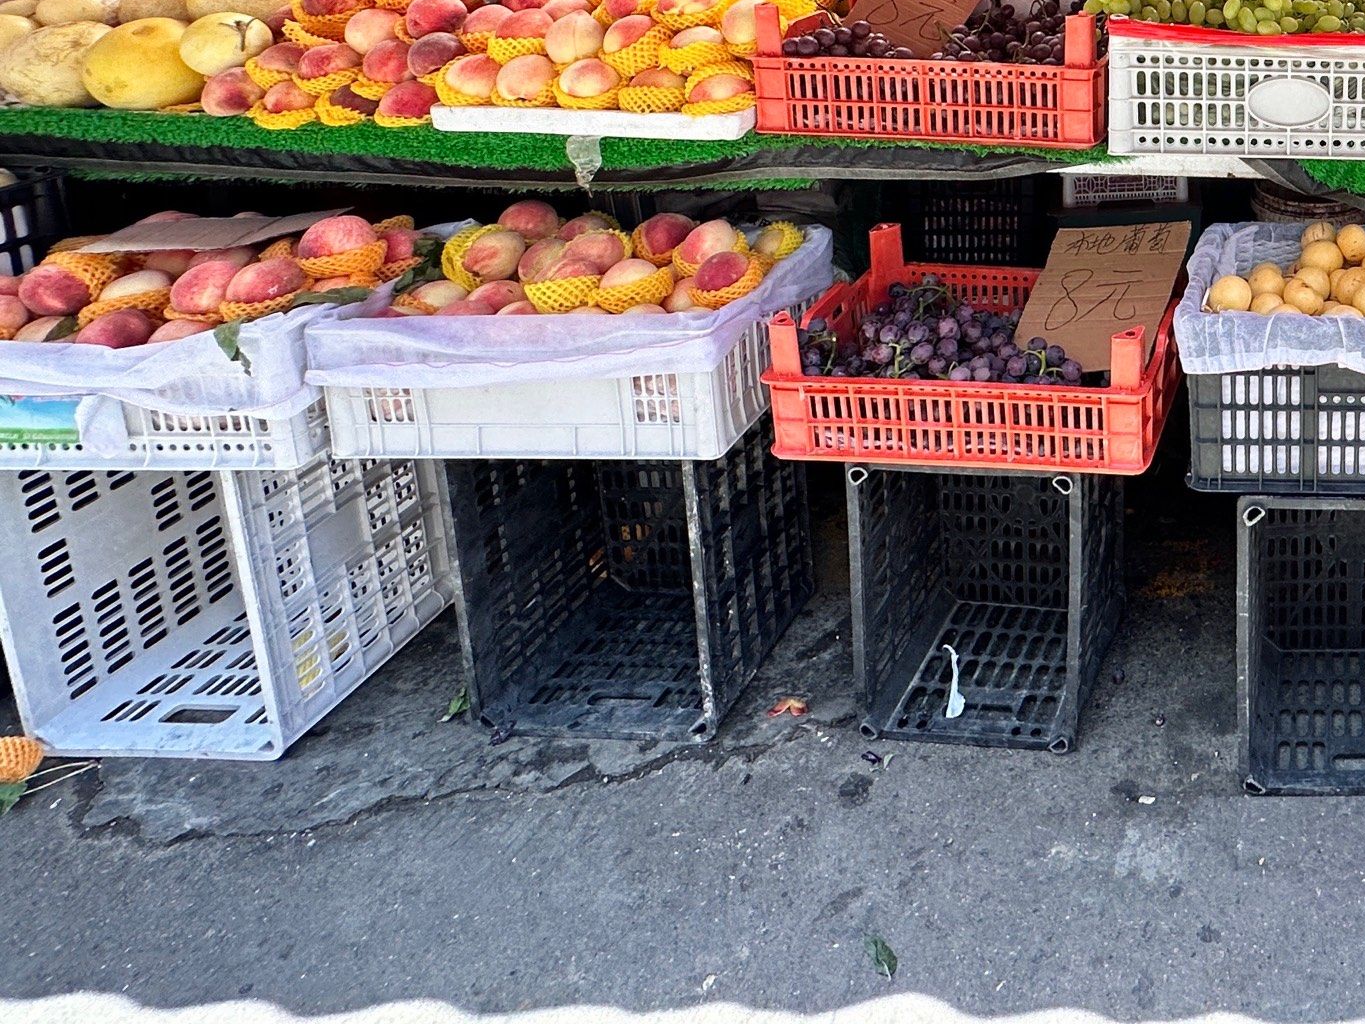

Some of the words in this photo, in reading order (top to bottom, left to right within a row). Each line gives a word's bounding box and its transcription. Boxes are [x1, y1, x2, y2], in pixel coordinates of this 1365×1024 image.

[1063, 225, 1171, 255] 本地葡萄
[1044, 268, 1144, 331] 8元
